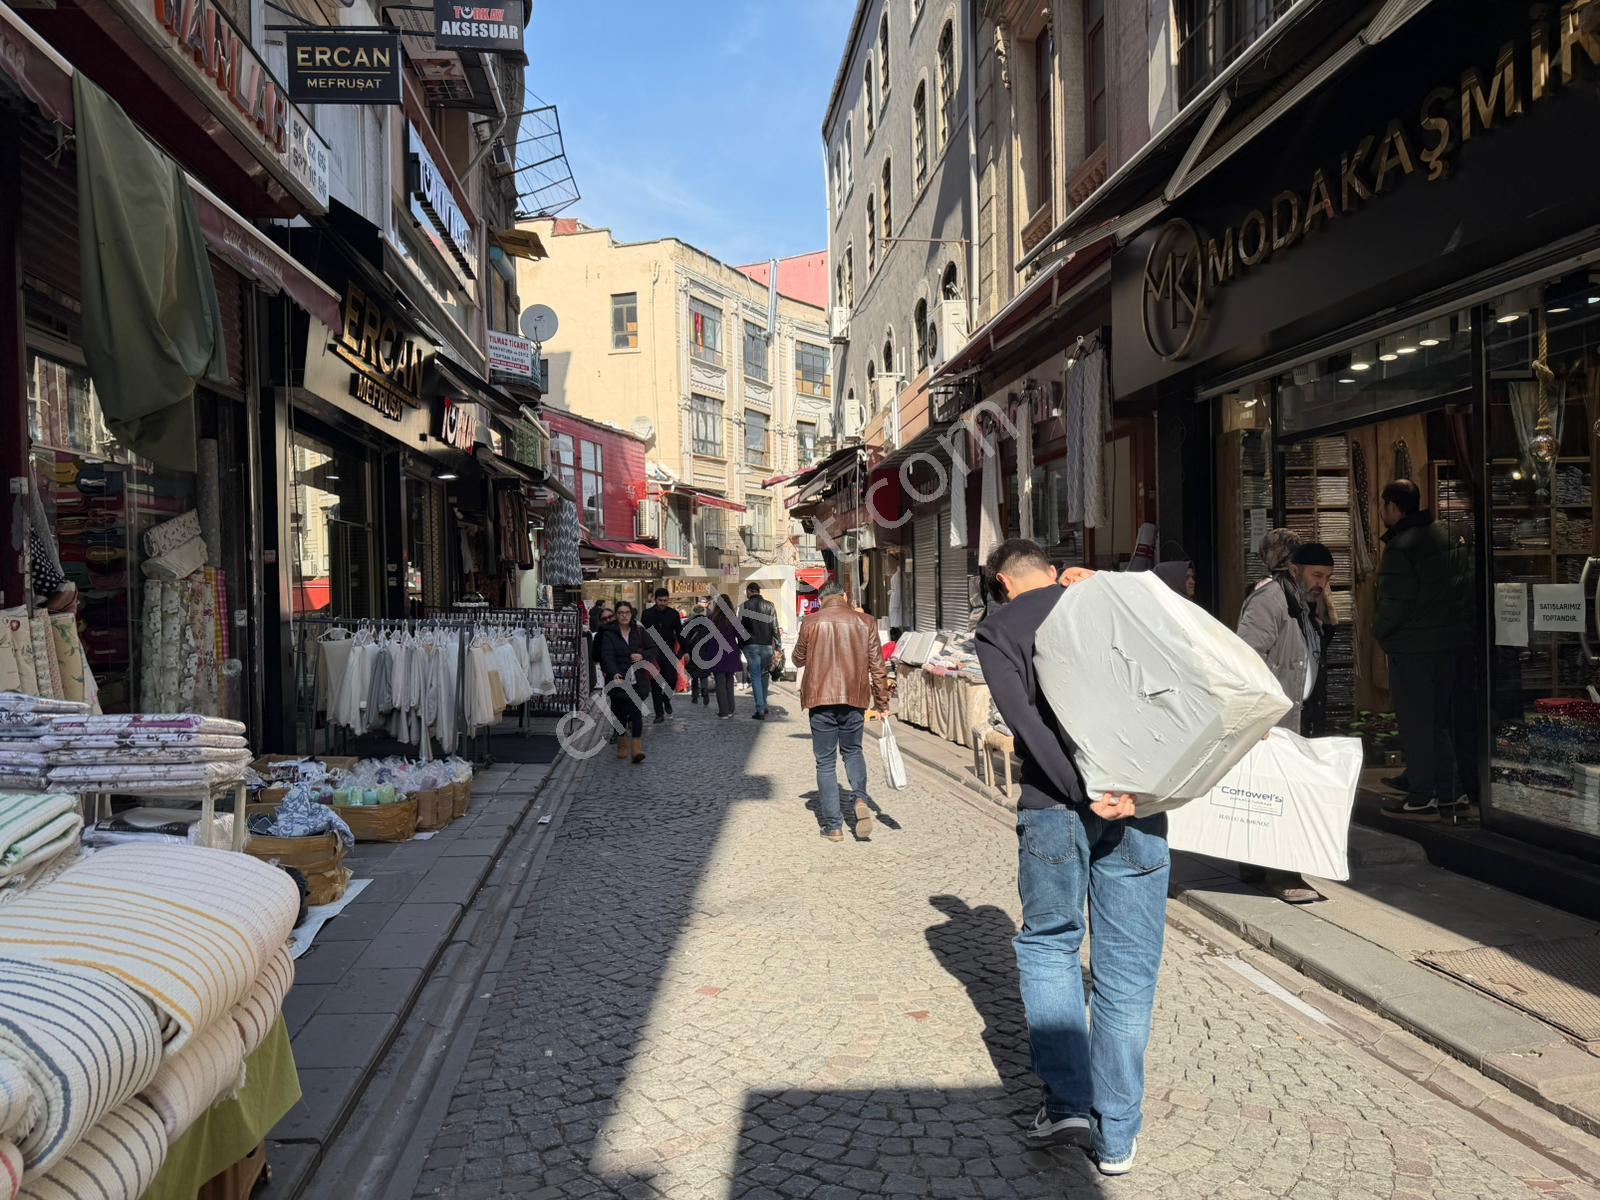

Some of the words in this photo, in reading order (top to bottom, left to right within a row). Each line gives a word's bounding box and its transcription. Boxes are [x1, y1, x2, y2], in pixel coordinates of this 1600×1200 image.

[441, 20, 519, 40] AKSESUAR
[296, 46, 391, 68] ERCAN
[307, 78, 382, 91] MEFRUŞAT
[341, 281, 423, 399] ERCAN
[608, 558, 638, 569] ÖZKAN
